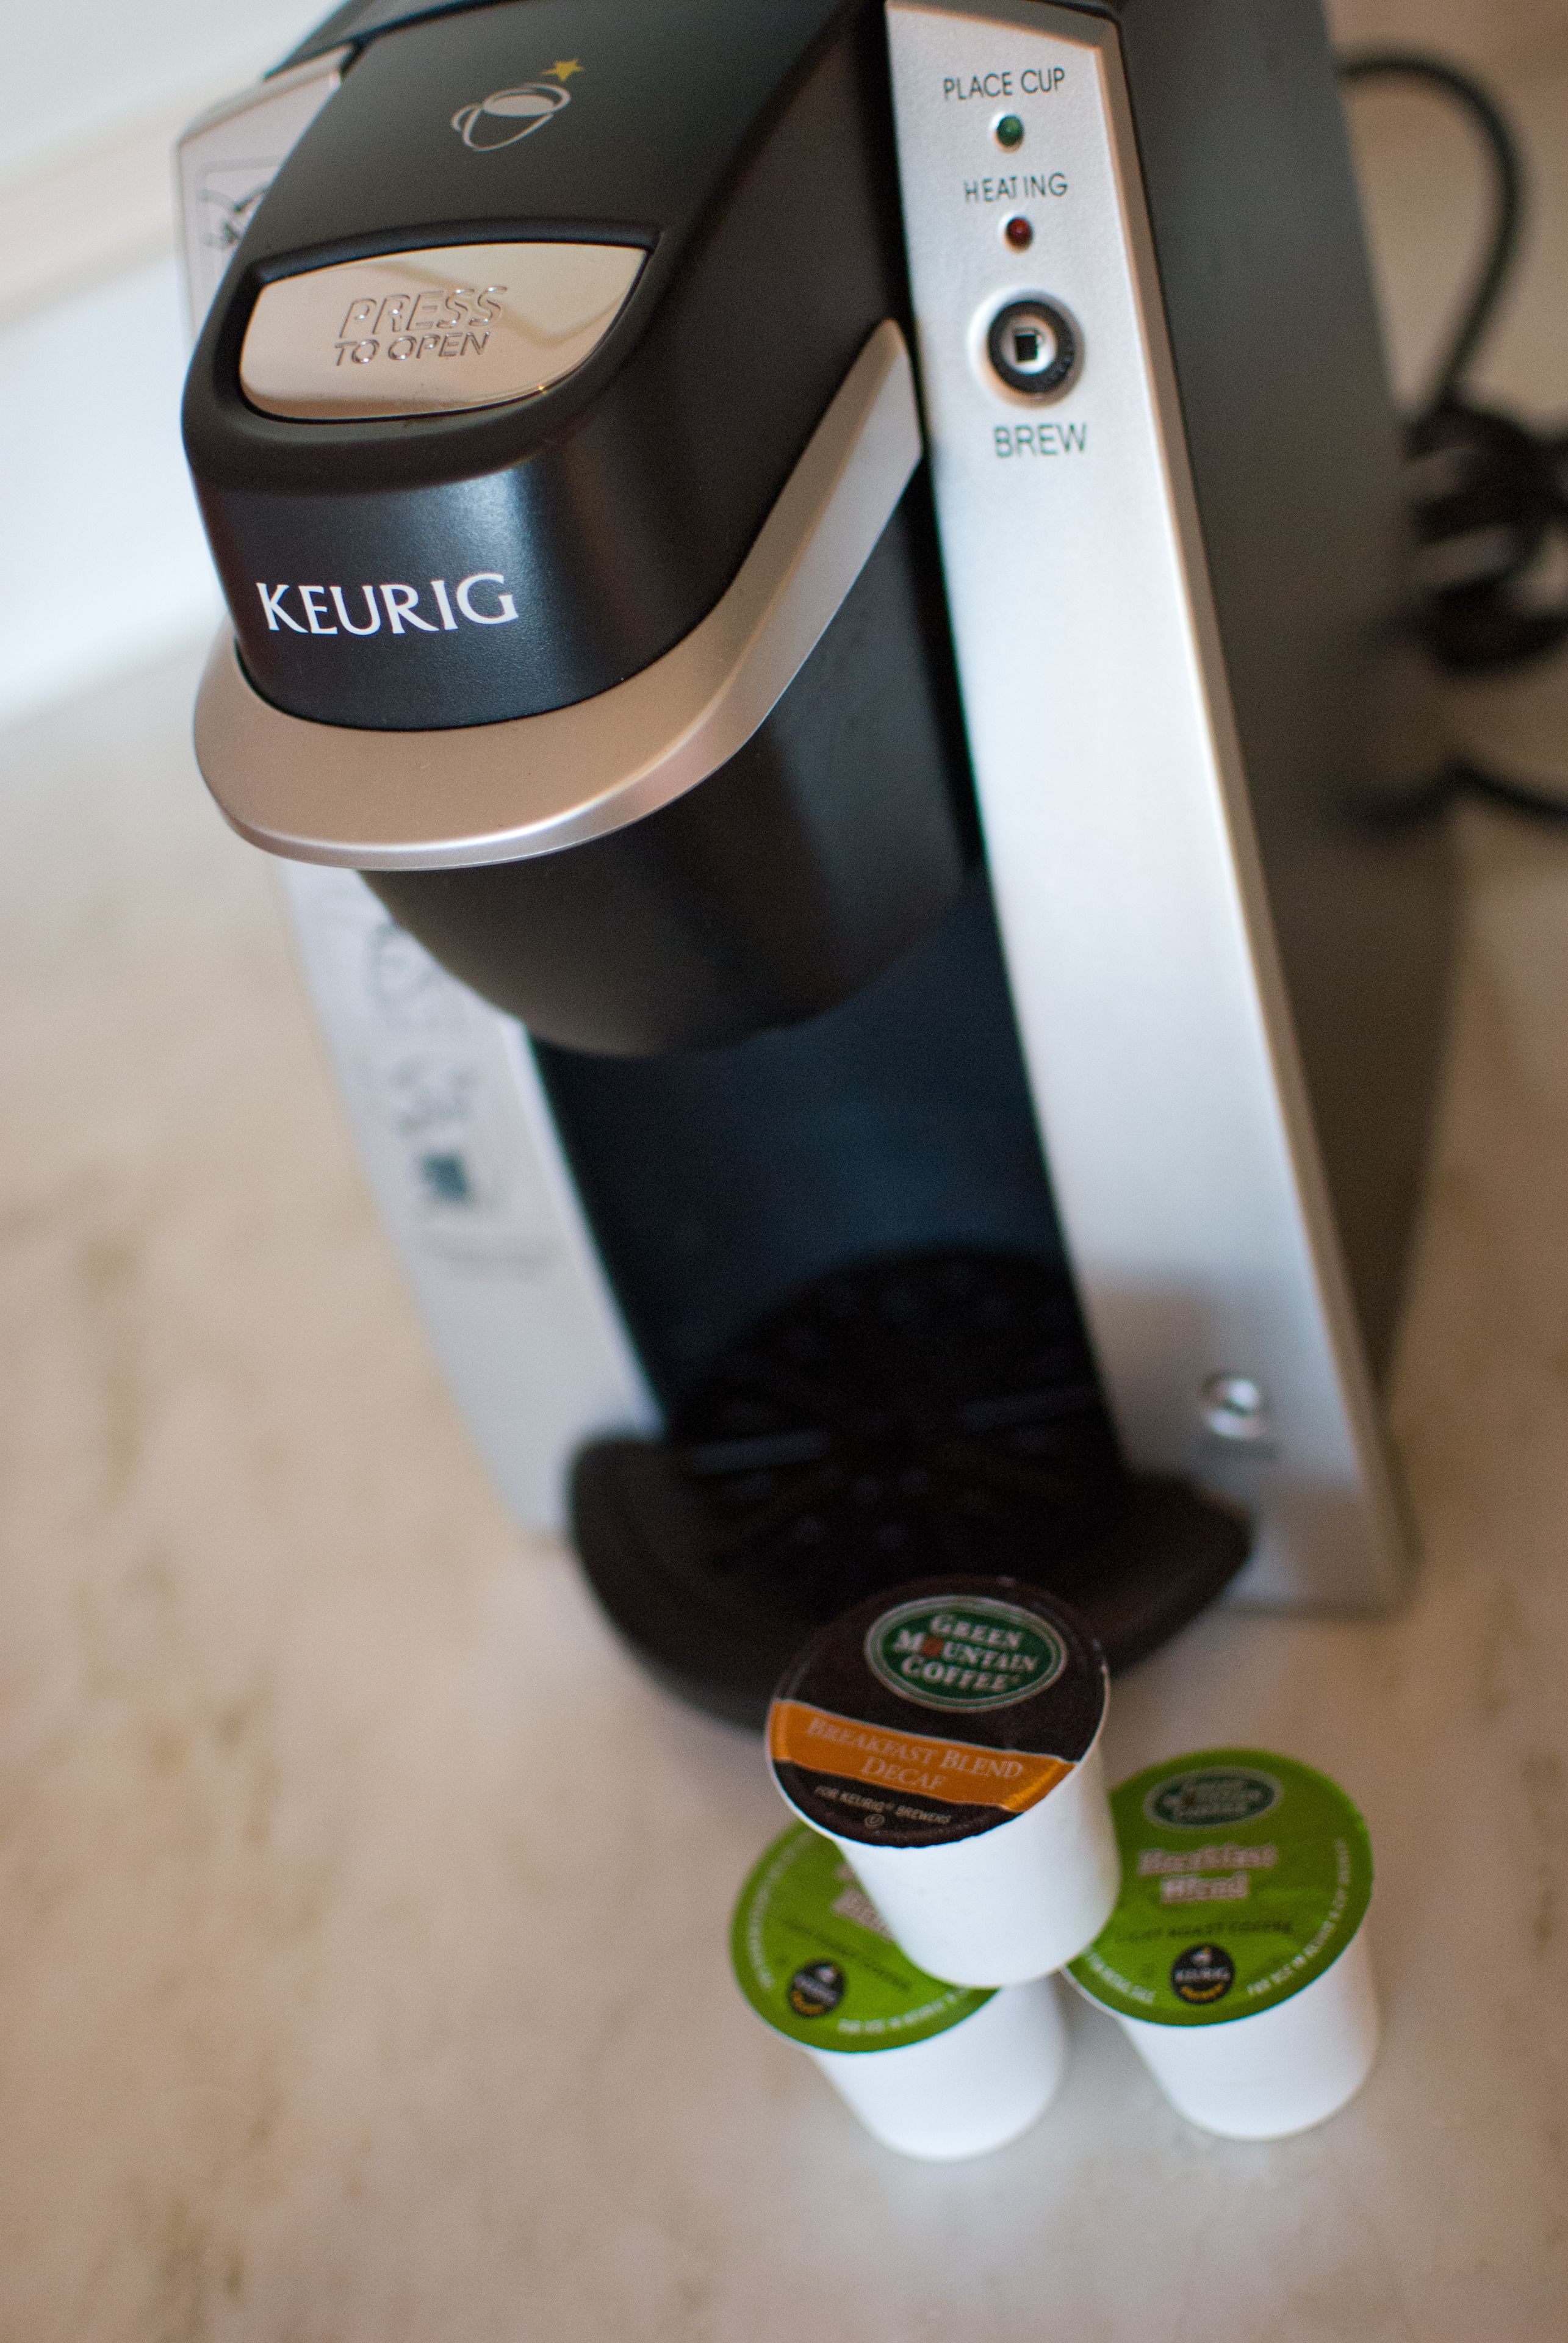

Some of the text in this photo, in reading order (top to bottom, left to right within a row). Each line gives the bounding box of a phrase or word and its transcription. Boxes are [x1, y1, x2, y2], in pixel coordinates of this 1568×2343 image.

[943, 66, 1066, 101] PLACE CUP
[963, 172, 1069, 203] HEATING
[338, 284, 508, 339] PRESS
[333, 332, 491, 367] TO OPEN
[993, 423, 1088, 458] BREW
[255, 572, 519, 636] KEURIG
[930, 1615, 1024, 1650] GREEN
[805, 1716, 1024, 1779] BREAKFAST BLEND
[861, 1756, 946, 1791] DECAF
